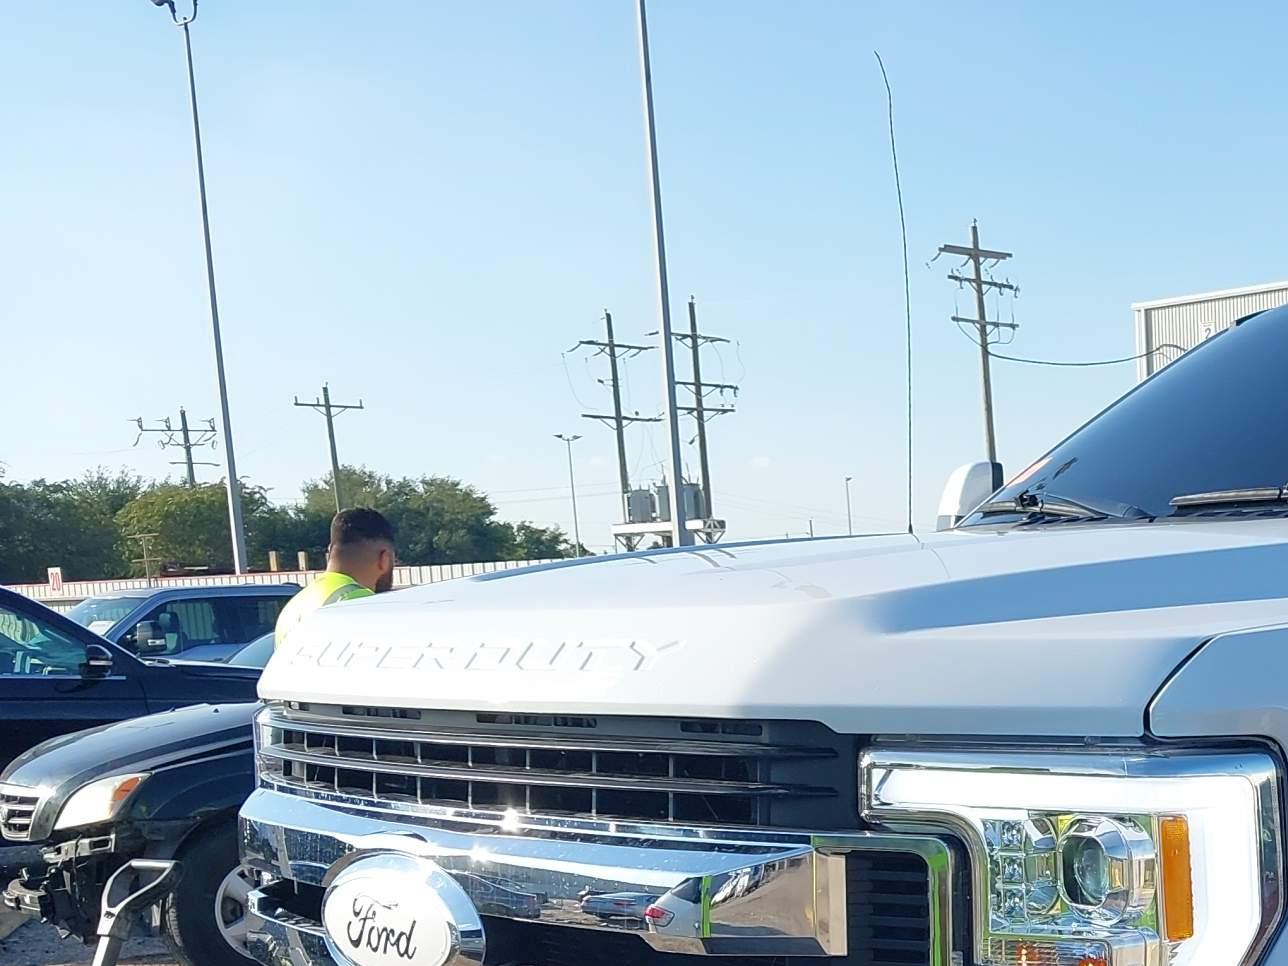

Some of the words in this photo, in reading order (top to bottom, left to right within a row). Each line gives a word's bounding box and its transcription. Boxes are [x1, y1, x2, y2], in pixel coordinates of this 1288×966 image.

[50, 571, 61, 591] 20
[463, 640, 688, 672] DUTY
[347, 893, 417, 960] Ford
